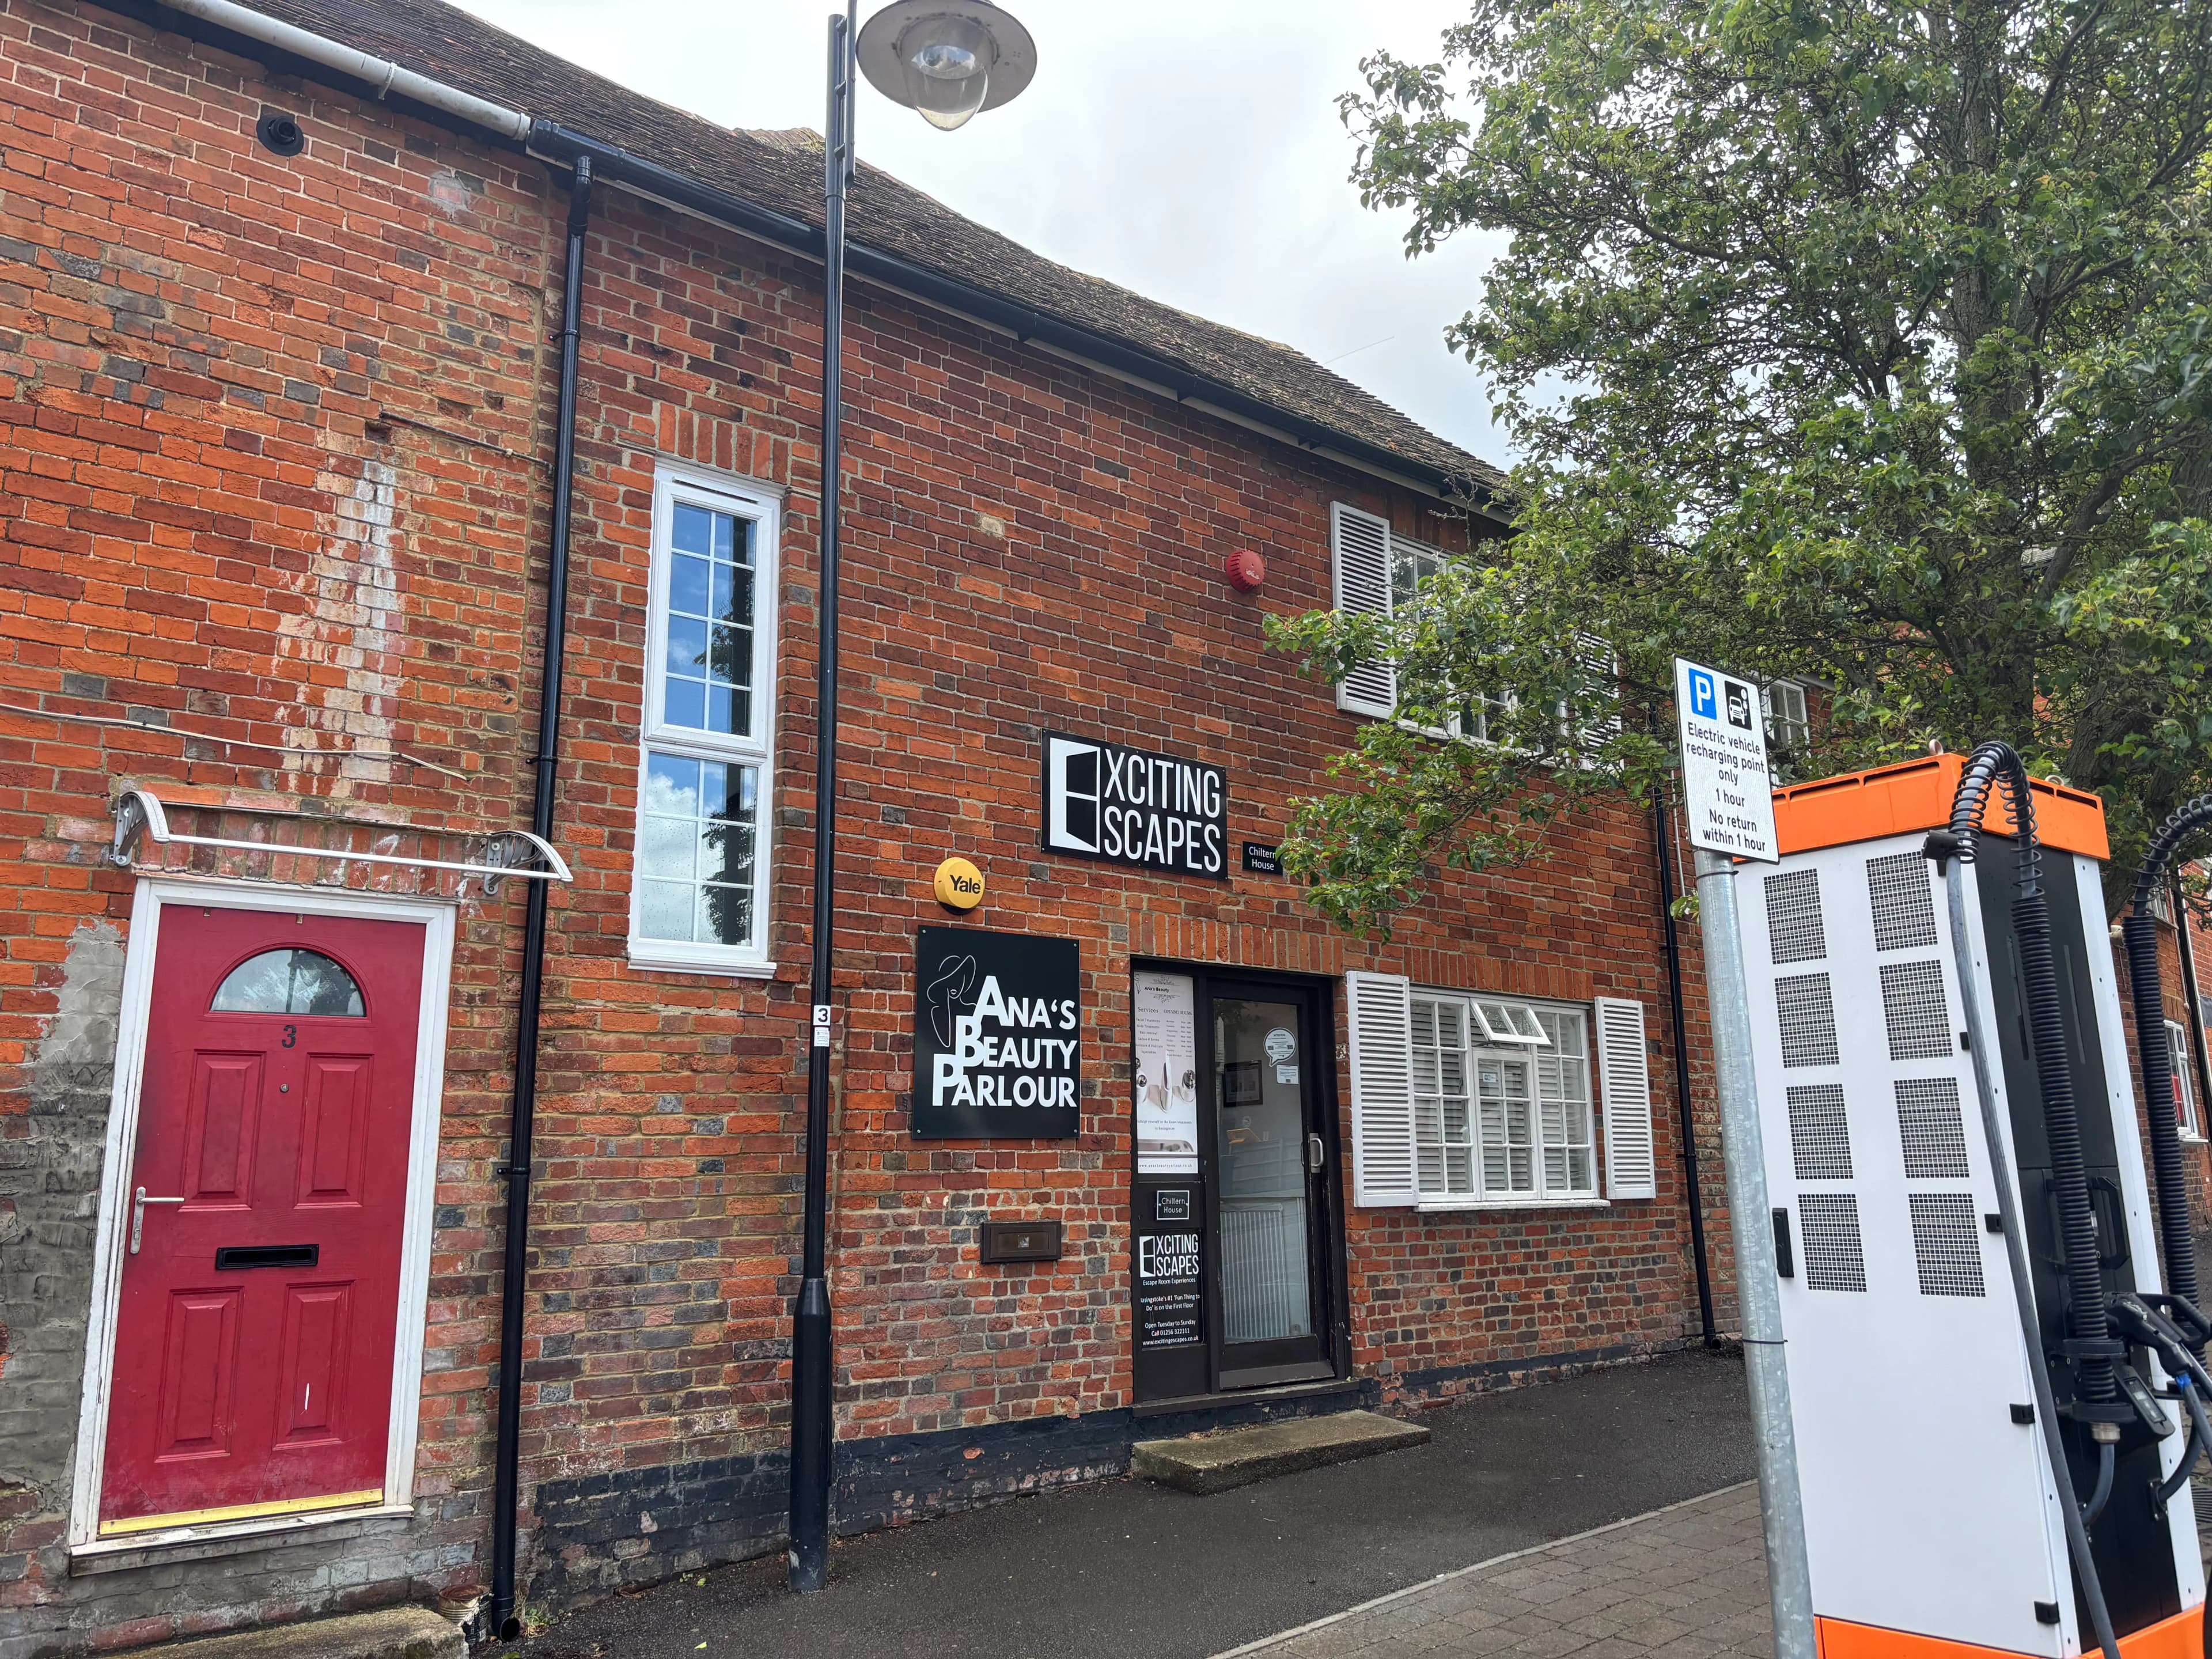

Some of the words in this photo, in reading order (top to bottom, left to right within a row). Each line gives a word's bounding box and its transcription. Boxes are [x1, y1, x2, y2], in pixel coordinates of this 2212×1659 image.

[1695, 675, 1711, 712] P
[1688, 722, 1725, 745] Electric
[1728, 734, 1760, 755] vehicle
[1687, 742, 1738, 768] recharging
[1741, 757, 1765, 774] point
[1718, 768, 1738, 786] only
[1715, 788, 1720, 801] 1
[1724, 790, 1745, 807] hour
[1709, 809, 1724, 825] No
[1727, 815, 1757, 832] return
[1703, 828, 1733, 847] within
[1737, 834, 1741, 847] 1
[1745, 835, 1766, 852] hour
[1252, 858, 1274, 870] House
[949, 874, 981, 894] Yale
[818, 1007, 828, 1022] 3
[281, 1025, 297, 1048] 3
[955, 1015, 1078, 1070] BEAUTY
[932, 1054, 1077, 1107] PARLOUR
[1161, 1196, 1185, 1205] Chiltern
[1142, 1335, 1199, 1346] www.excitingescapes.co.uk
